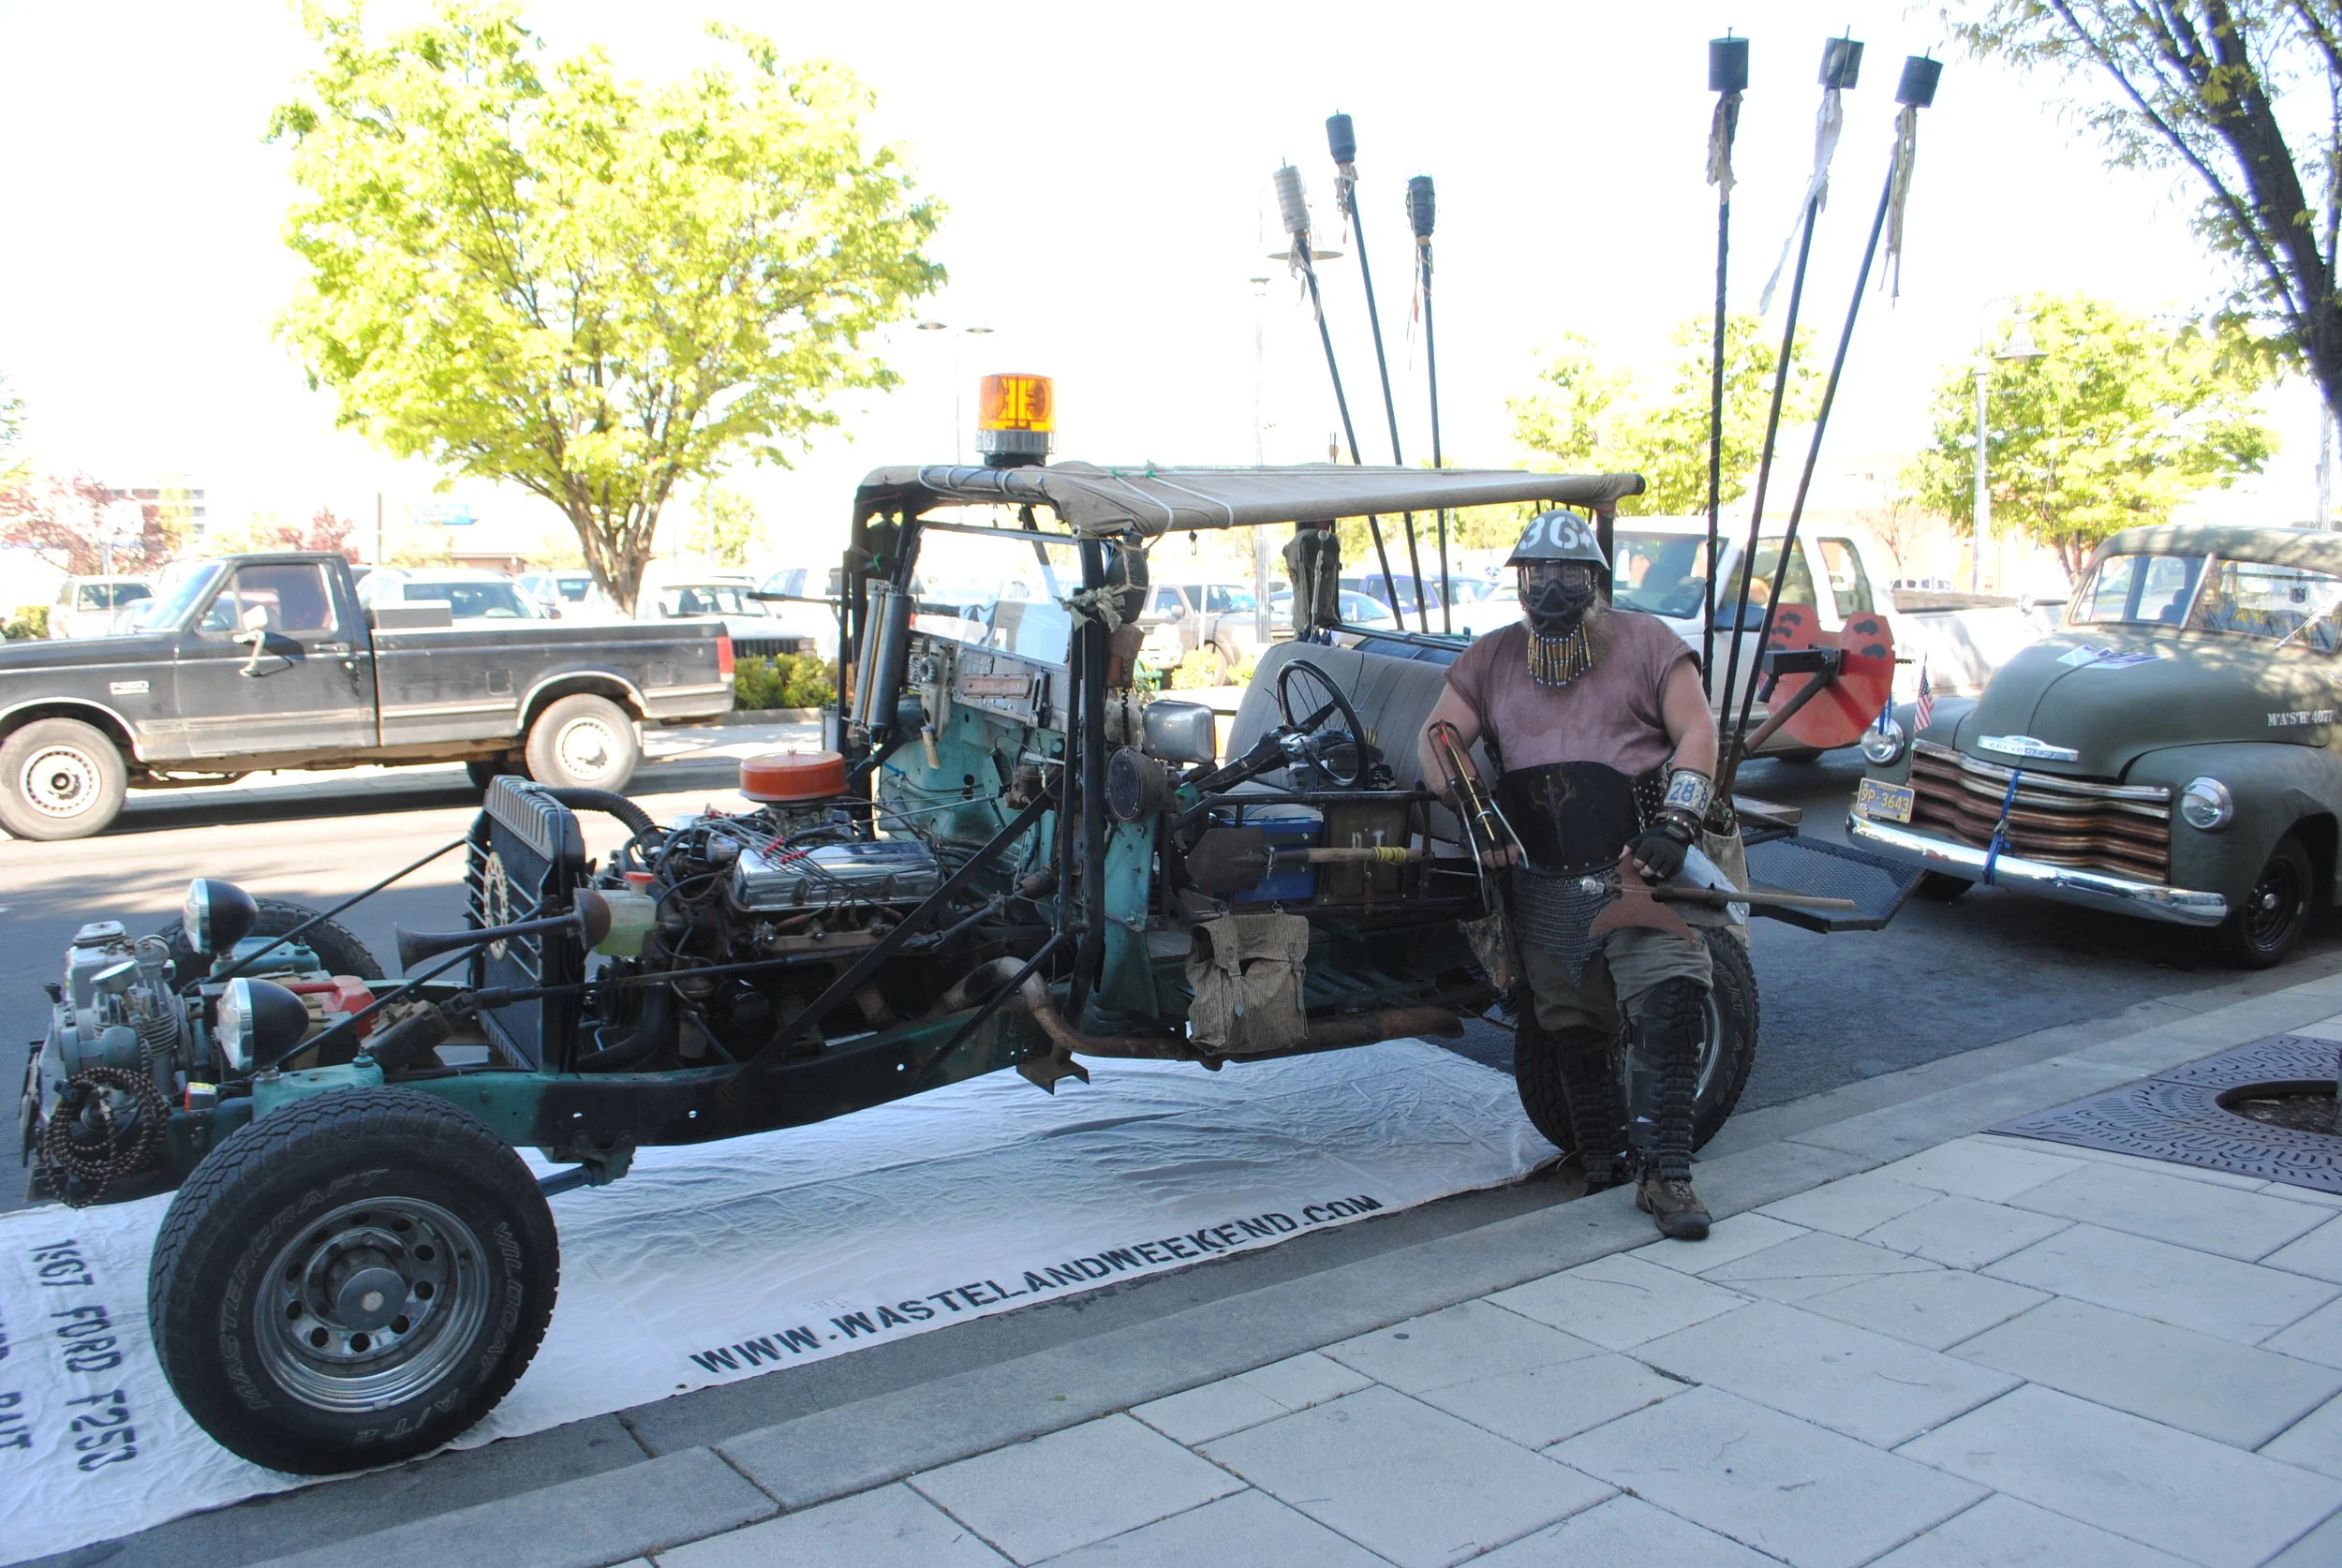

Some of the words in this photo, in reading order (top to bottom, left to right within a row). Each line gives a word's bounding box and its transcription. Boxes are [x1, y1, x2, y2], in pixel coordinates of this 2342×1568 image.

[1519, 516, 1579, 551] 36
[2311, 709, 2335, 724] 4077
[1669, 781, 1696, 803] 28
[219, 1168, 390, 1410] MASTERCRAFT
[479, 1221, 524, 1383] WILDCAT
[689, 1194, 1384, 1375] WWW.WASTELANDWEEKEND.COM
[50, 1305, 123, 1373] FORD
